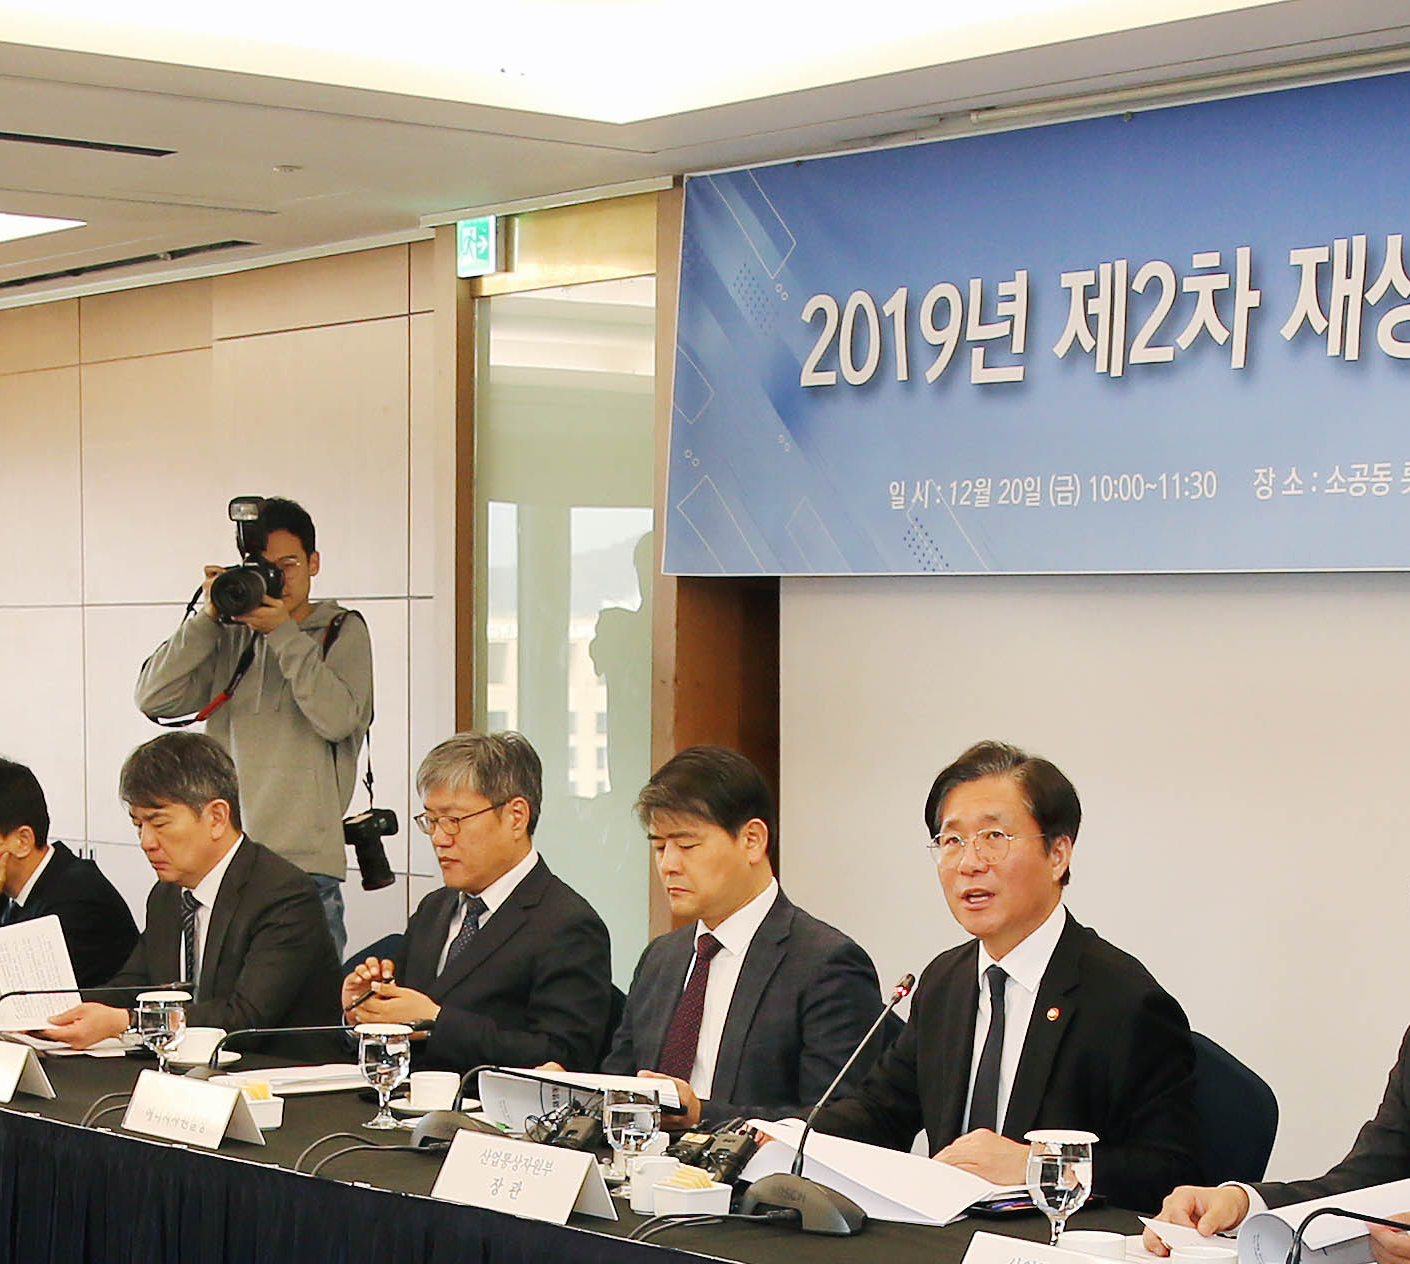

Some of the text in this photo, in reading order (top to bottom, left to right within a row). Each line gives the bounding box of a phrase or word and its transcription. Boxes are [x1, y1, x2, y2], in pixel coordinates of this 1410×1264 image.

[799, 269, 1029, 387] 2019년
[1052, 246, 1261, 377] 제2차
[948, 477, 992, 508] 12월
[997, 475, 1041, 507] 20일
[1049, 473, 1081, 507] (금)
[1089, 470, 1218, 502] 10:00~11:30
[1324, 462, 1393, 497] 소공동
[480, 1148, 555, 1177] 산업통상자원부
